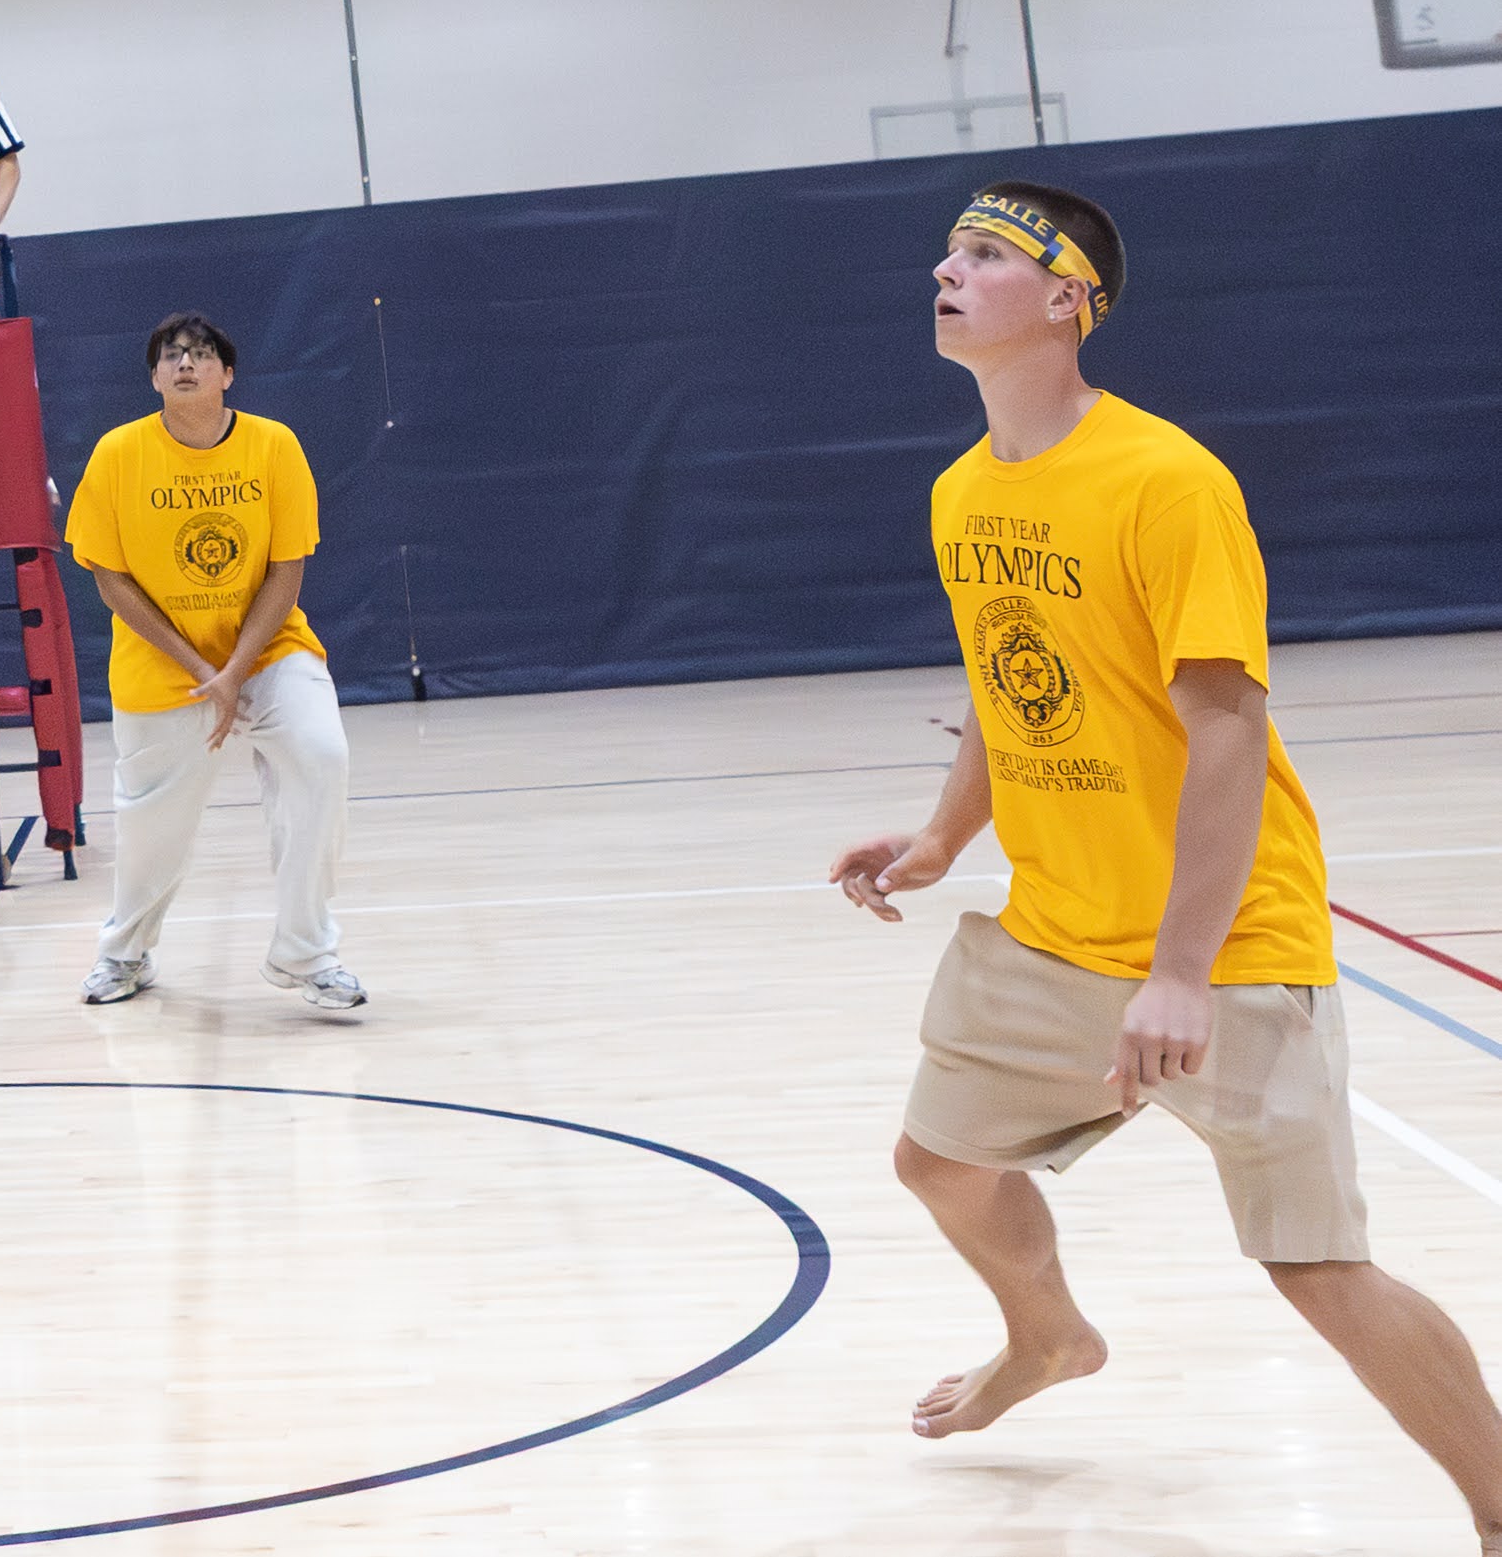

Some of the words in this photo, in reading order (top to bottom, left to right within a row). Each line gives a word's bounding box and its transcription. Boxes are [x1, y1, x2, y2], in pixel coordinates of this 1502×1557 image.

[977, 194, 1055, 237] SALLE
[174, 475, 205, 486] FIRST
[210, 470, 242, 484] YEAR
[151, 479, 262, 509] OLYMPICS
[965, 515, 1005, 537] FIRST
[1010, 518, 1051, 543] YEAR
[940, 542, 1082, 599] OLYMPICS
[1026, 733, 1054, 744] 1863
[1040, 759, 1054, 776] IS
[1057, 758, 1103, 776] GAME
